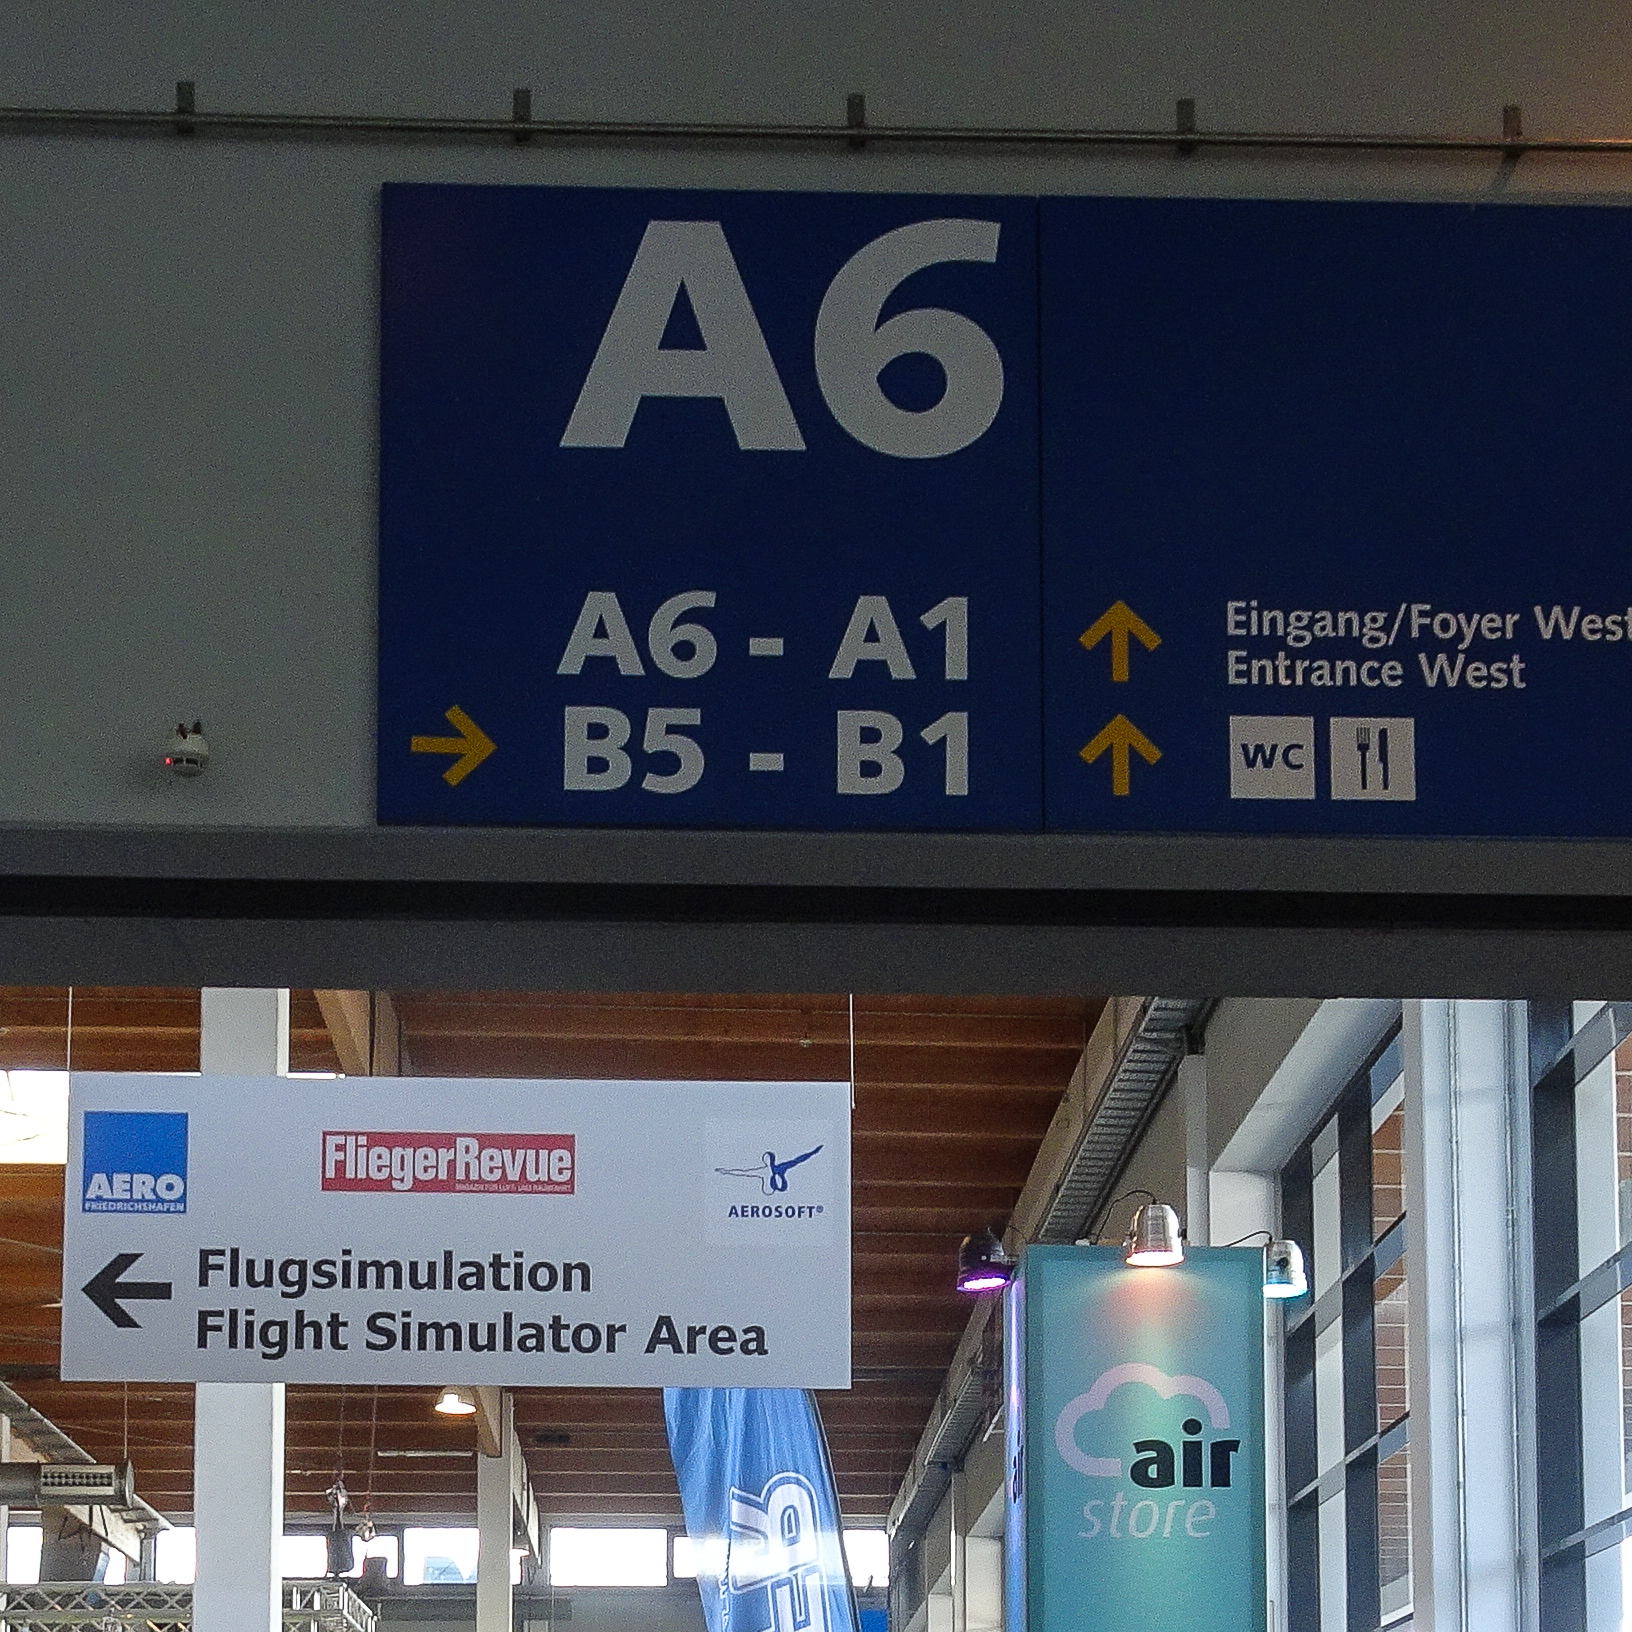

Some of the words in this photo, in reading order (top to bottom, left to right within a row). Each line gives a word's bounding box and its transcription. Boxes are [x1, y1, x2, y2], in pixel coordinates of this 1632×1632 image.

[559, 217, 1005, 459] A6
[556, 589, 719, 680] A6
[828, 594, 969, 681] A1
[1226, 600, 1522, 649] Eingang/Foyer
[1227, 651, 1403, 689] Entrance
[1417, 654, 1528, 690] West
[563, 706, 706, 794] B5
[835, 711, 970, 797] B1
[1240, 739, 1306, 773] WC
[86, 1172, 185, 1201] AERO
[325, 1134, 573, 1191] FliegerRevue
[84, 1201, 185, 1212] FRIEDRICHSHAFEN
[198, 1247, 593, 1299] Flugsimulation
[196, 1309, 349, 1360] Flight
[365, 1309, 627, 1355] Simulator
[644, 1315, 770, 1357] Area
[1130, 1418, 1241, 1489] air
[1077, 1491, 1217, 1538] store
